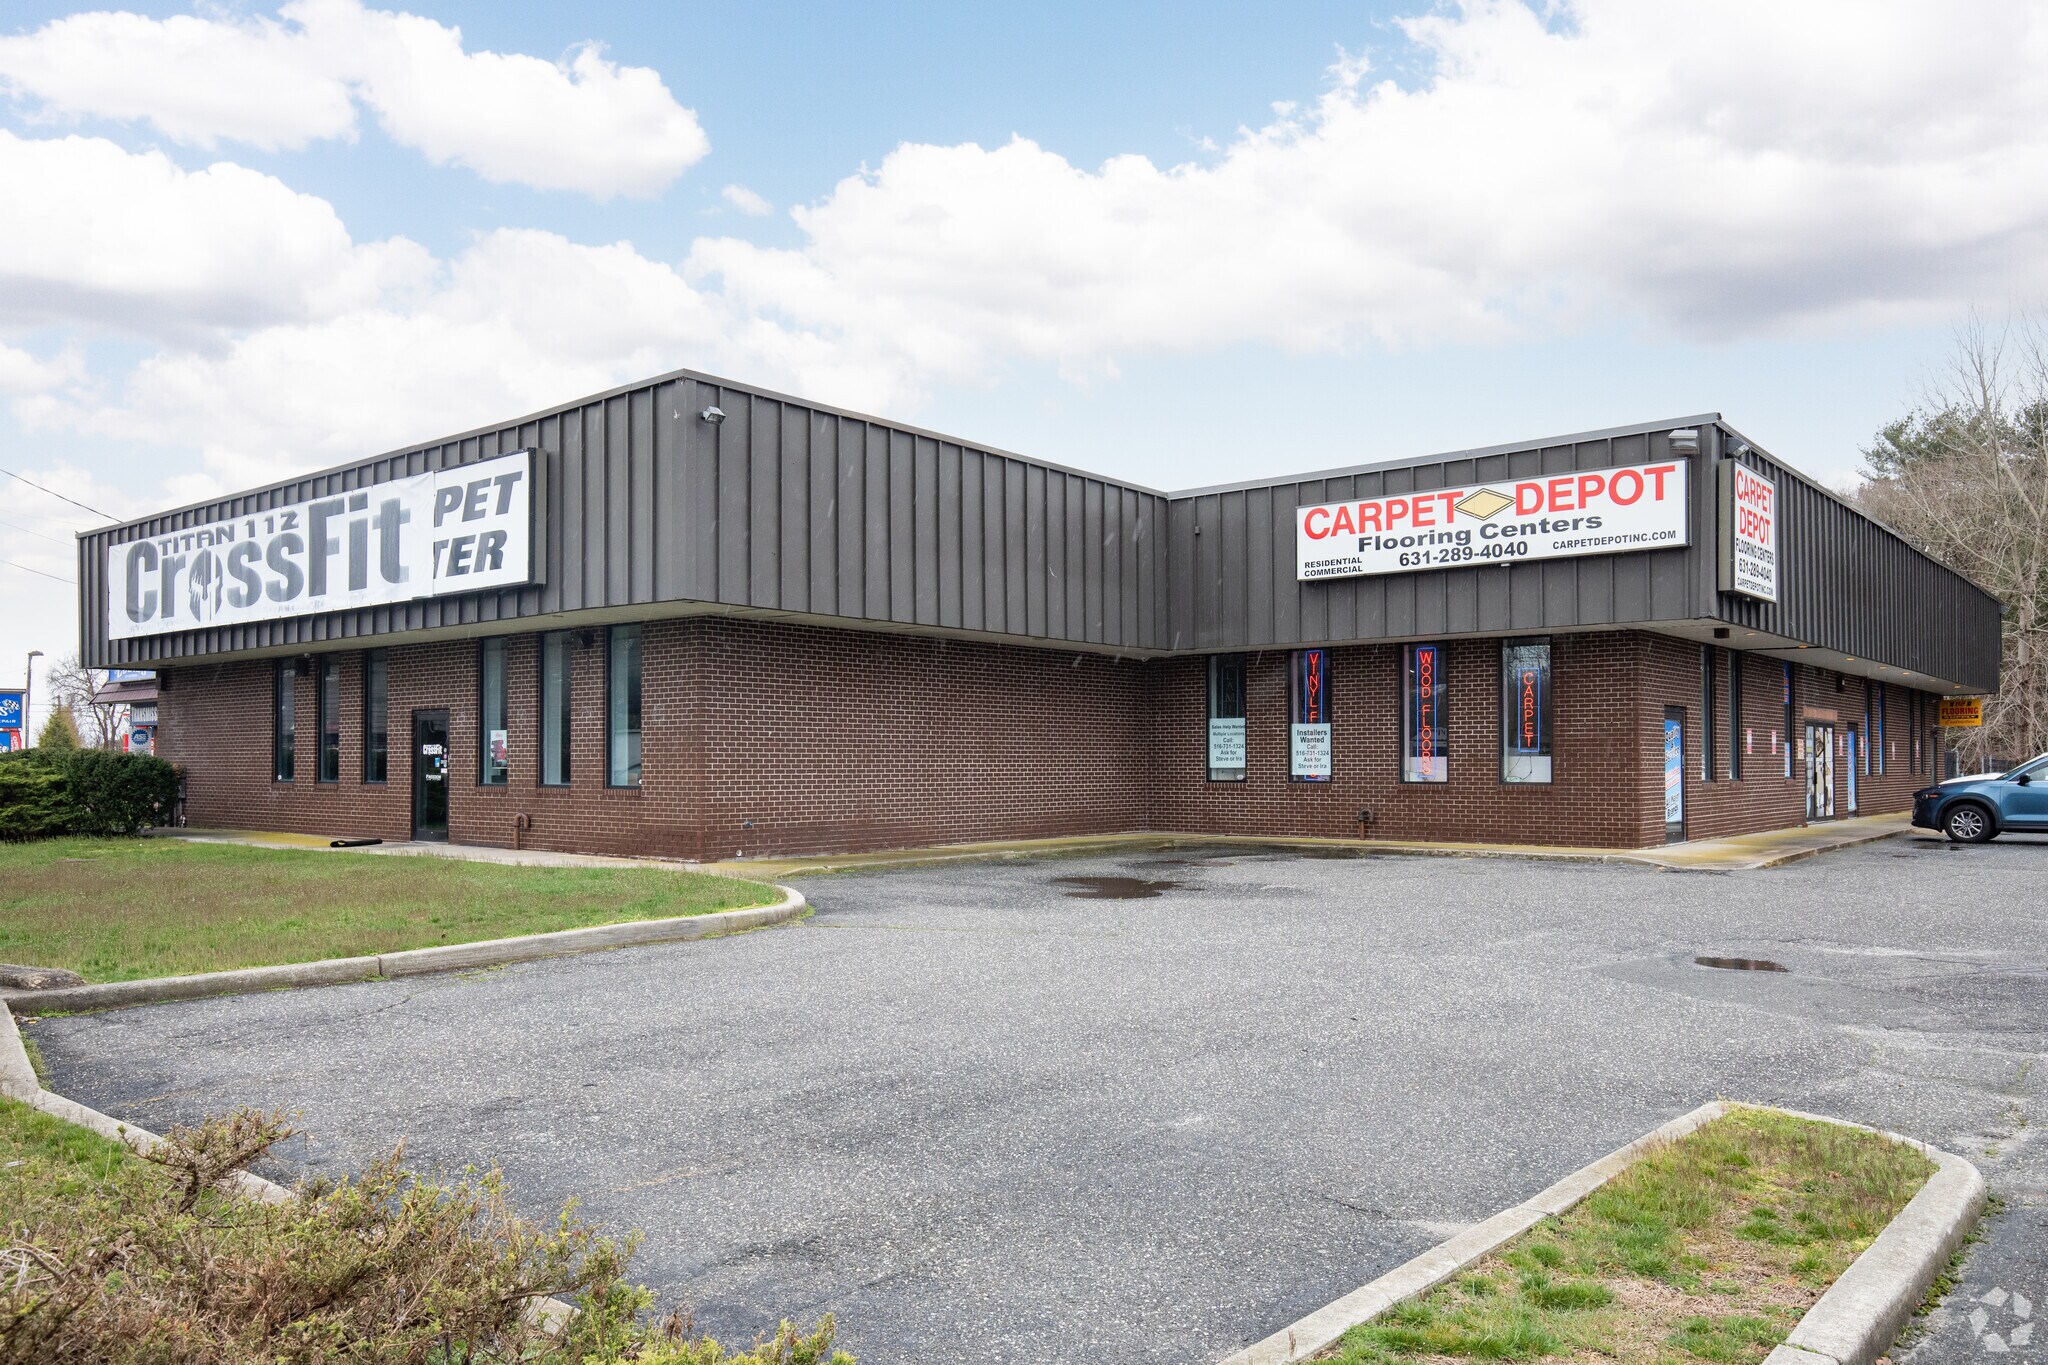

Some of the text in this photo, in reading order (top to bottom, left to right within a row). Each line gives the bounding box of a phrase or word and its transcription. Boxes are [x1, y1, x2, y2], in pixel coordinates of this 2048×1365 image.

[433, 471, 523, 528] PET
[1304, 465, 1676, 540] CARPET DEPOT
[1736, 470, 1772, 514] CARPET
[157, 511, 299, 556] TITAN 112
[1358, 516, 1603, 552] Flooring Centers
[1552, 530, 1677, 550] CARPETDEPOTINC.COM
[1739, 506, 1770, 545] DEPOT
[126, 492, 411, 624] CrossFit
[1304, 556, 1363, 569] RESIDENTIAL
[1304, 565, 1363, 577] COMMERCIAL
[1399, 541, 1528, 567] 631-289-4040
[1736, 537, 1774, 566] FLOORING CENTERS
[1738, 557, 1773, 583] 631-289-4040
[1309, 653, 1319, 708] VINYL
[1419, 651, 1433, 775] WOOD FLOORS
[1523, 672, 1534, 748] CARPET
[1941, 707, 1979, 715] FLOORING
